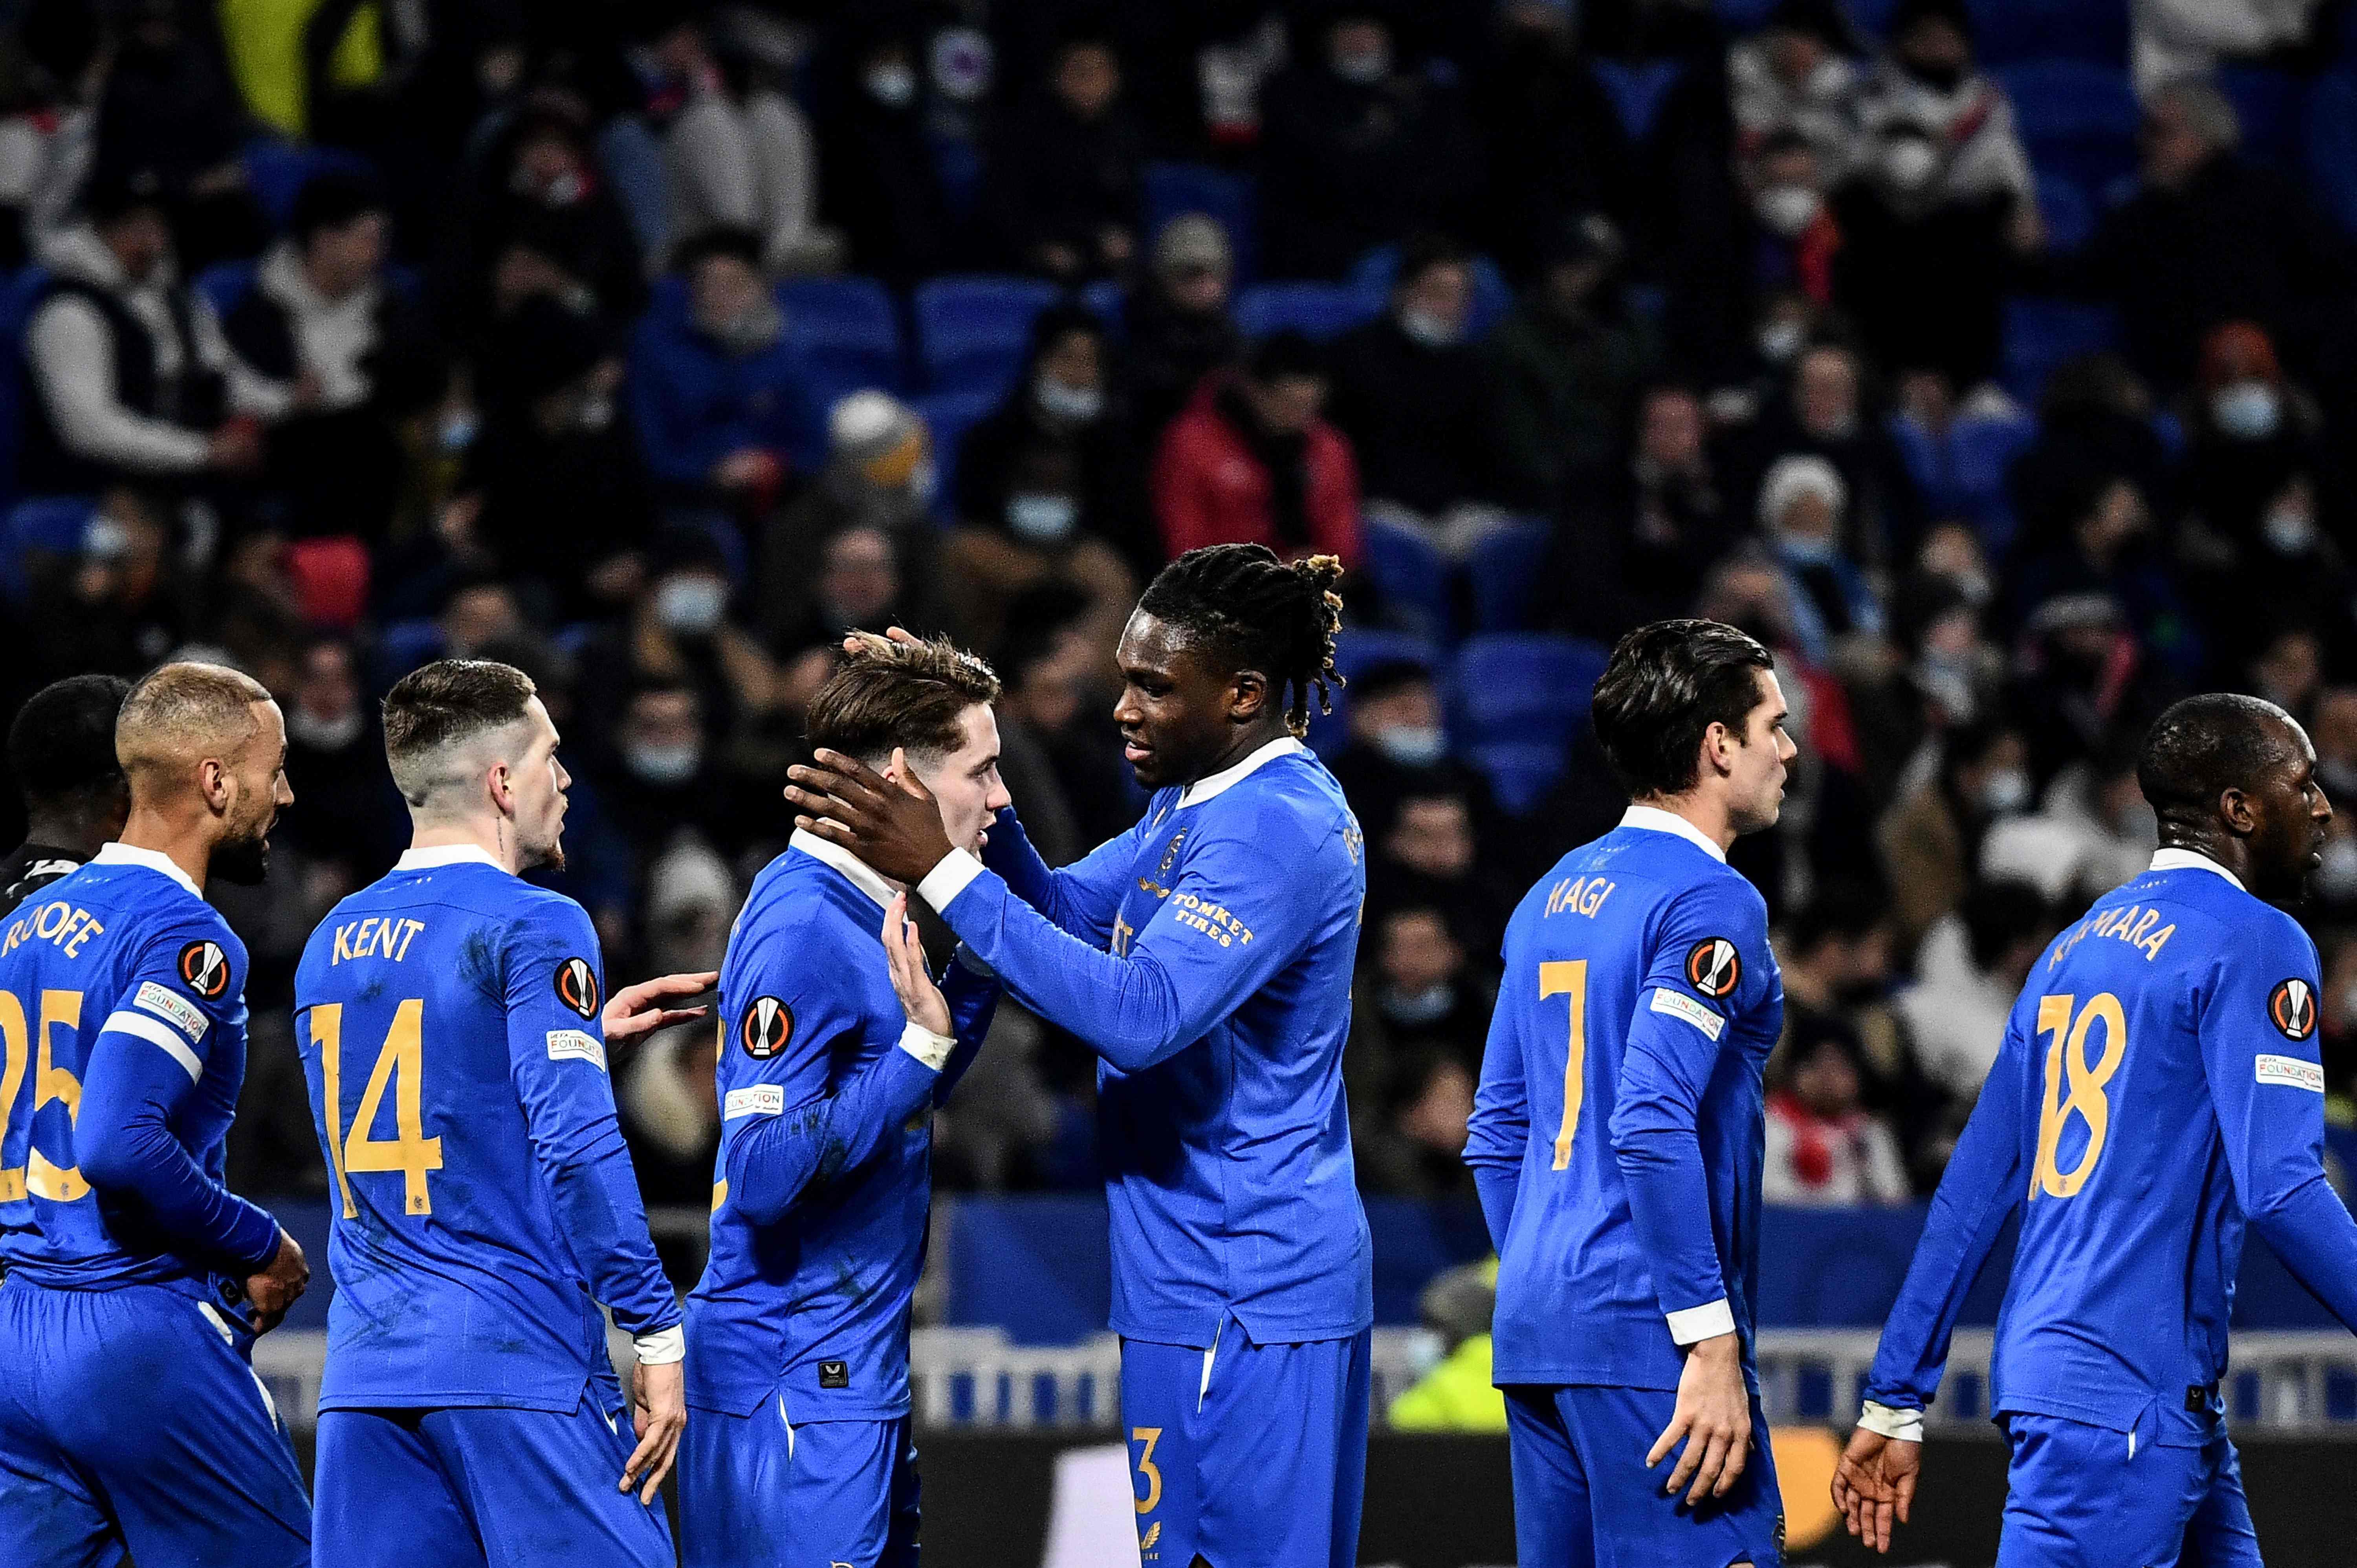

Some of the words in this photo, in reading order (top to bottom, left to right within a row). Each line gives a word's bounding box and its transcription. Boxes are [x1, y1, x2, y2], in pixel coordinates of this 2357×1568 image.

[1, 901, 104, 959] ROOFE
[332, 917, 425, 966] KENT
[1172, 894, 1254, 945] TOMKET
[1175, 909, 1232, 948] TIRES
[140, 989, 204, 1036] FOUNDATION
[1657, 994, 1720, 1031] FOUNDATION
[1539, 959, 1587, 1171] 7
[2260, 1064, 2322, 1083] FOUNDATION
[0, 989, 92, 1202] 25
[310, 998, 443, 1219] 14
[2028, 992, 2126, 1200] 18
[1133, 1427, 1163, 1514] 3
